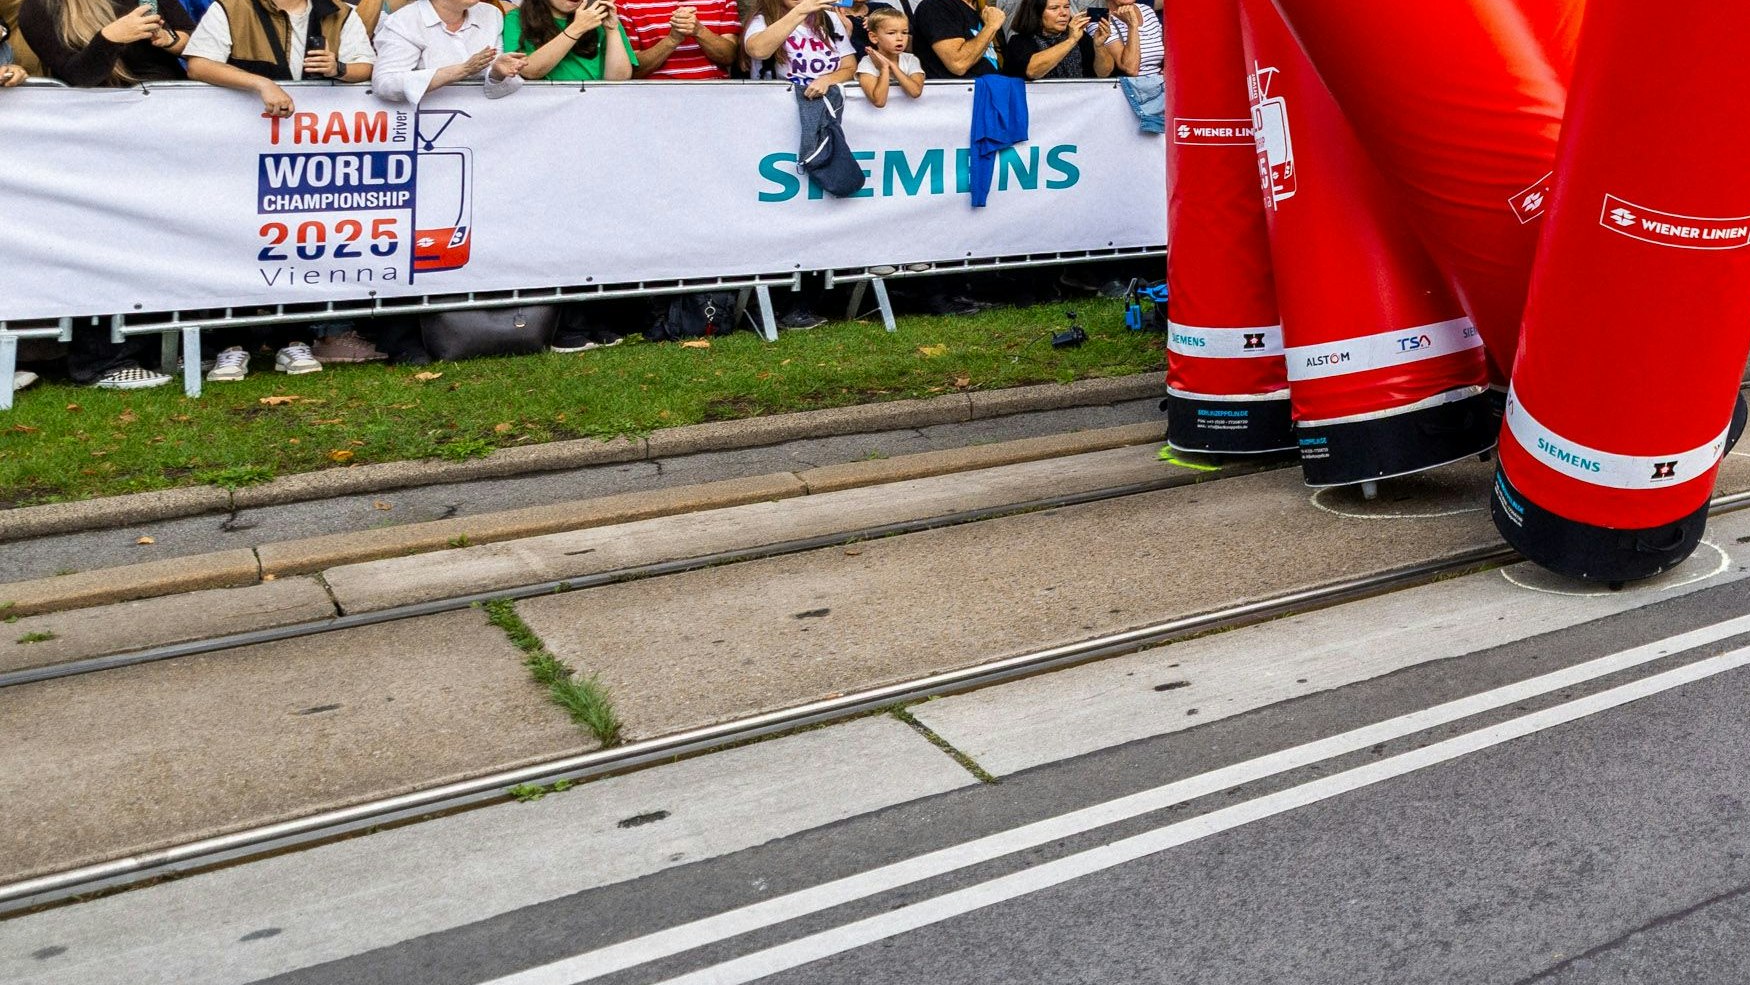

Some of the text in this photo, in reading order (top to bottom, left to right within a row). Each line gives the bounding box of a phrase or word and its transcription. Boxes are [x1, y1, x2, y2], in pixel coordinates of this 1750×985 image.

[261, 111, 388, 145] TRAM
[392, 110, 408, 143] Driver
[1193, 127, 1254, 137] WIENER LIN
[264, 153, 413, 188] WORLD
[263, 190, 410, 211] CHAMPIONSHIP
[257, 218, 399, 261] 2025
[1641, 219, 1700, 239] WIENER
[1702, 226, 1748, 240] LINIEN
[259, 265, 398, 286] Vienna
[1306, 351, 1351, 367] ALSTOM
[1537, 437, 1601, 473] SIEMENS
